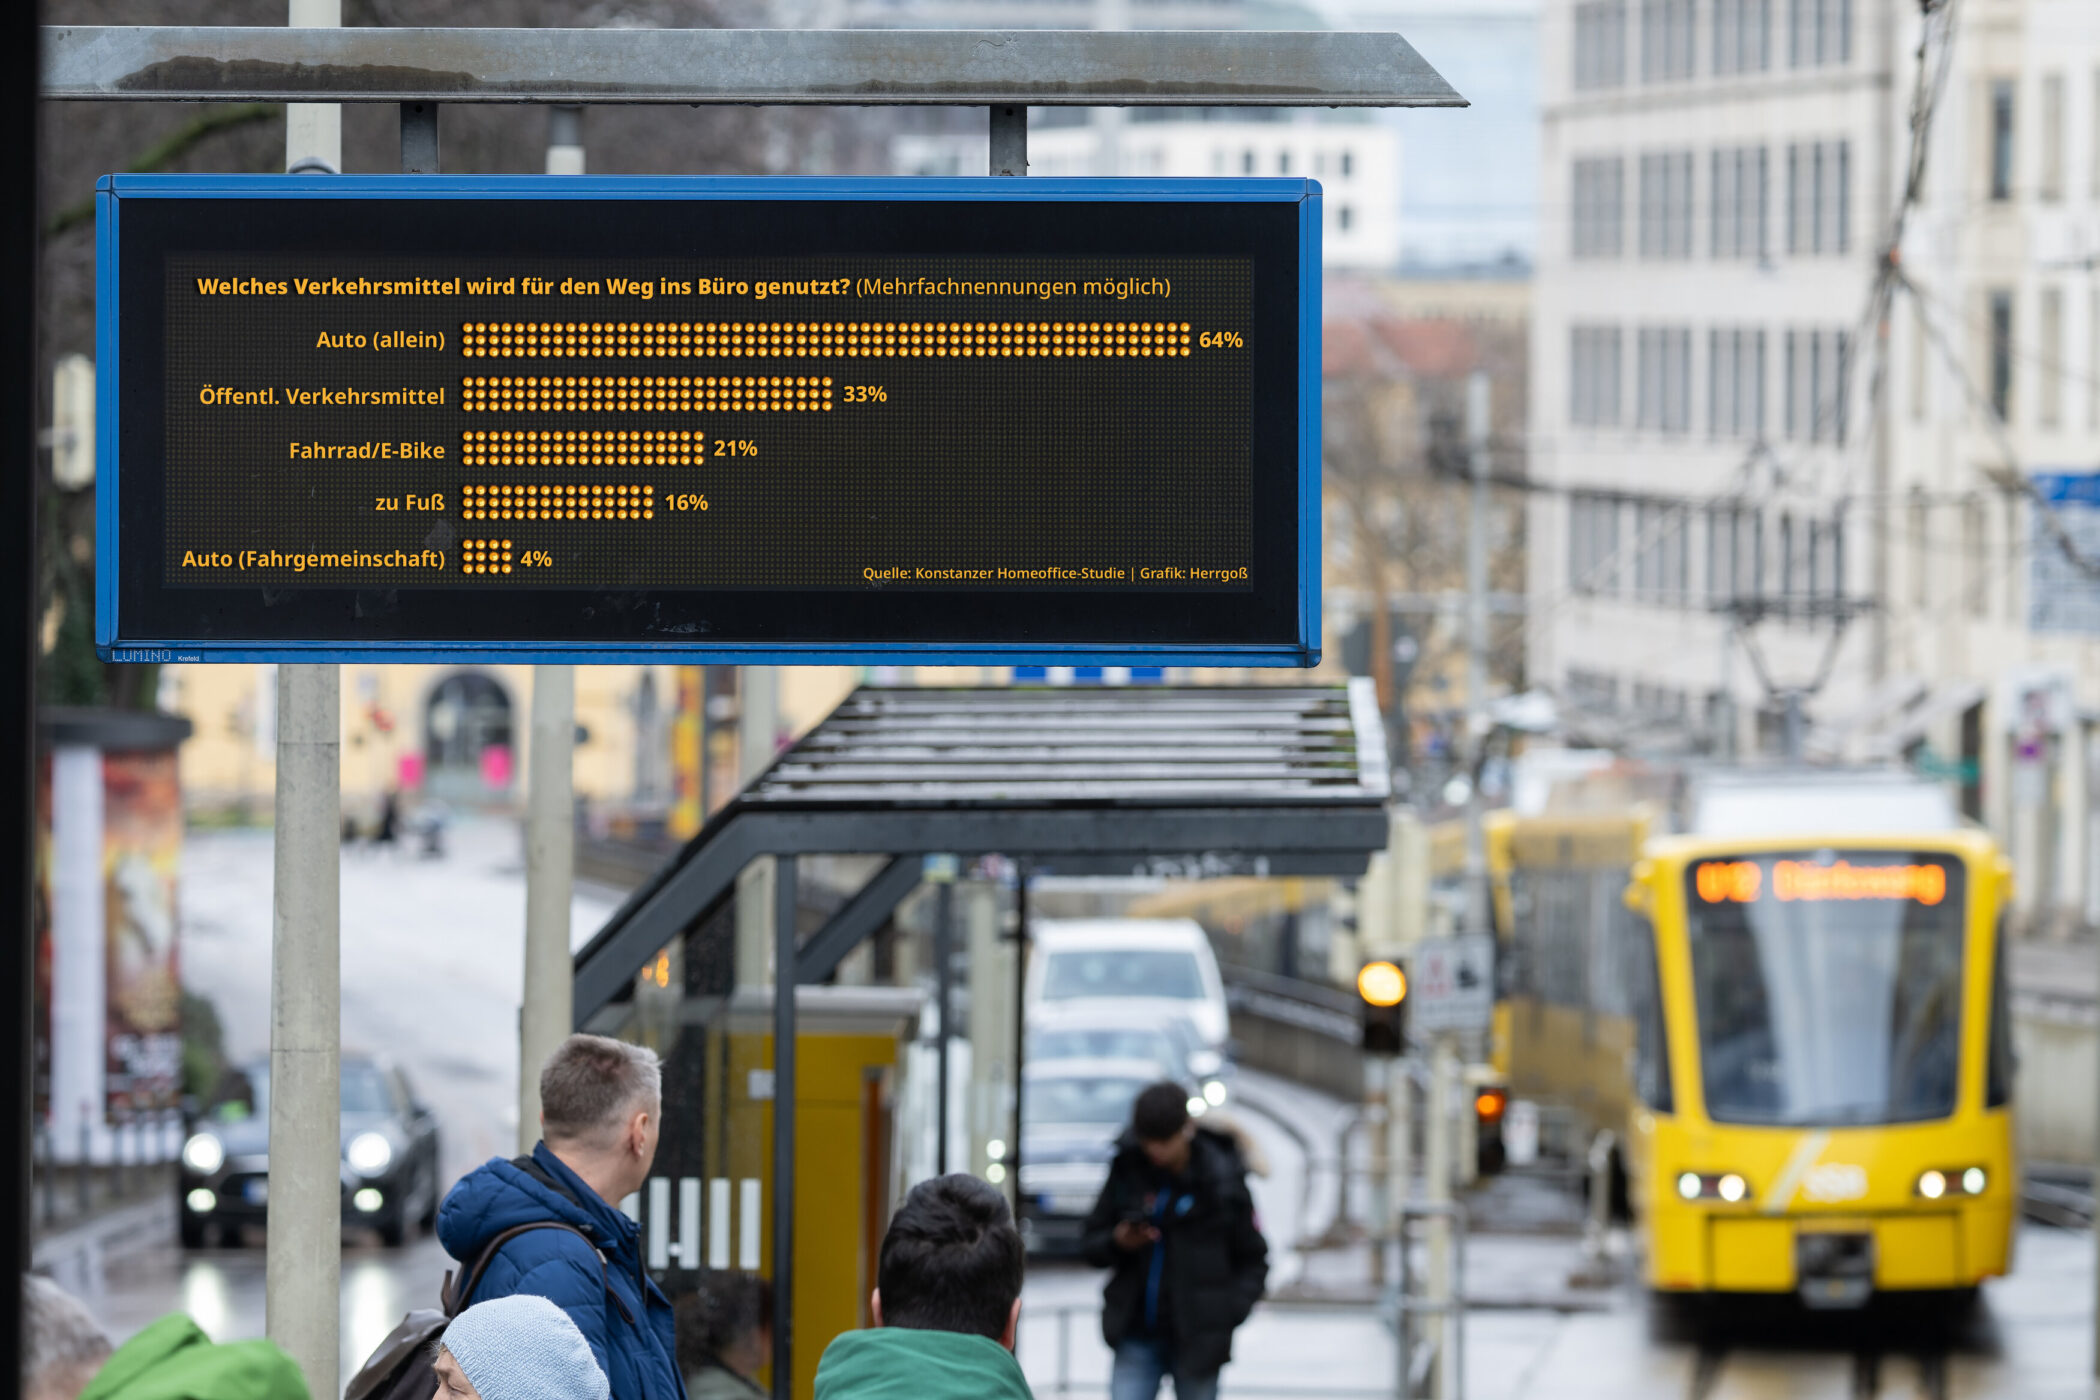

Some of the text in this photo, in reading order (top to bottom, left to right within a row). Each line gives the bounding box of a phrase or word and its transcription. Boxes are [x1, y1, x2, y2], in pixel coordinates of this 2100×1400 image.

[196, 276, 1171, 300] Welches Verkehrsmittel wird für den Weg ins Büro genutzt? (Mehrfachnennungen möglich)
[316, 330, 445, 352] Auto (allein)
[1199, 331, 1244, 348] 64%
[199, 383, 445, 405] Öffentl. Verkehrsmittel
[843, 385, 888, 403] 33%
[289, 441, 446, 460] Fahrrad/E-Bike
[713, 439, 758, 457] 21%
[375, 493, 446, 511] zu Fuß
[665, 493, 709, 511] 16%
[181, 549, 445, 572] Auto (Fahrgemeinschaft)
[520, 550, 553, 568] 4%
[863, 566, 912, 582] Quelle:
[915, 566, 994, 580] Konstanzer
[997, 566, 1125, 580] Homeoffice-Studie
[1140, 566, 1186, 580] Grafik:
[1190, 566, 1248, 583] Herrgoß
[112, 649, 200, 663] LUMINO Krefeld
